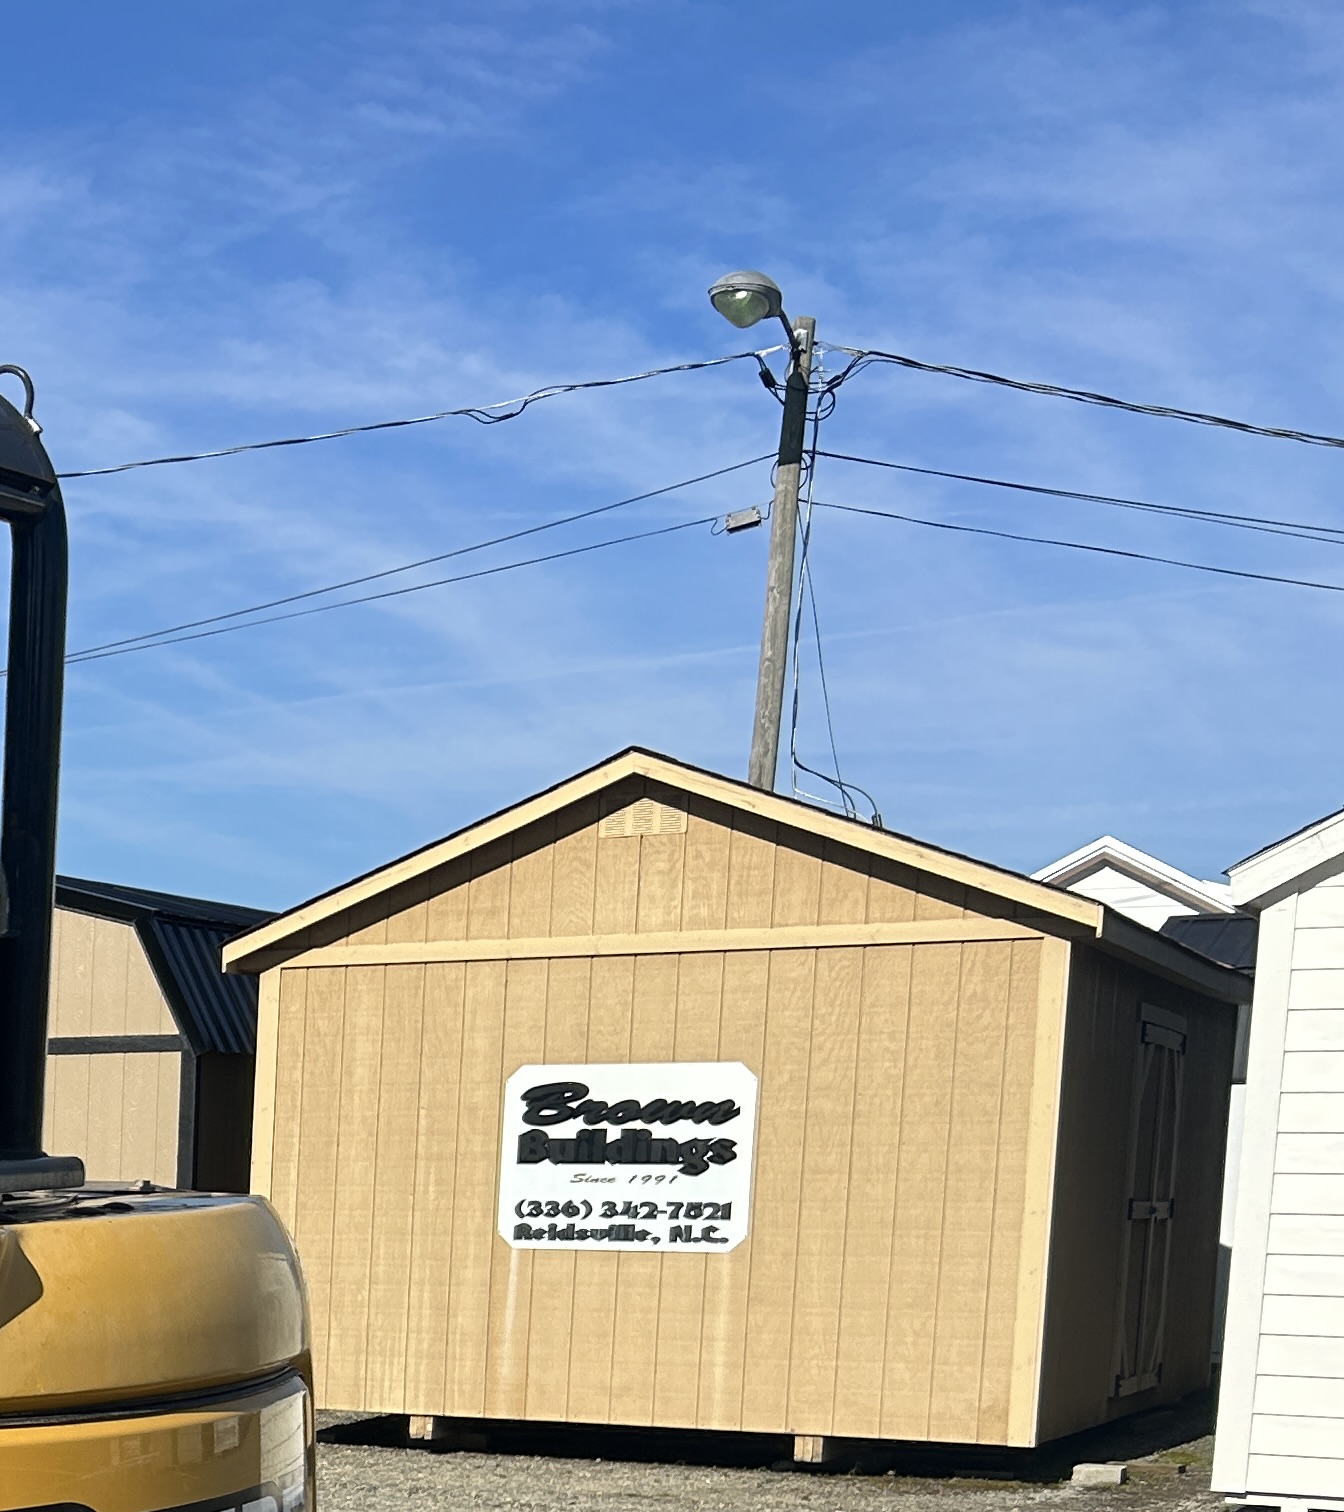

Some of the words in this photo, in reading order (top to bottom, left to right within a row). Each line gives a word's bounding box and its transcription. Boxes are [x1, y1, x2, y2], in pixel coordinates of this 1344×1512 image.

[520, 1081, 741, 1126] Brown
[517, 1128, 738, 1176] Buildings
[569, 1172, 617, 1185] Since
[628, 1173, 678, 1185] 1991
[514, 1198, 593, 1220] (336)
[513, 1222, 661, 1245] Reidsville,
[668, 1224, 729, 1244] N.C.
